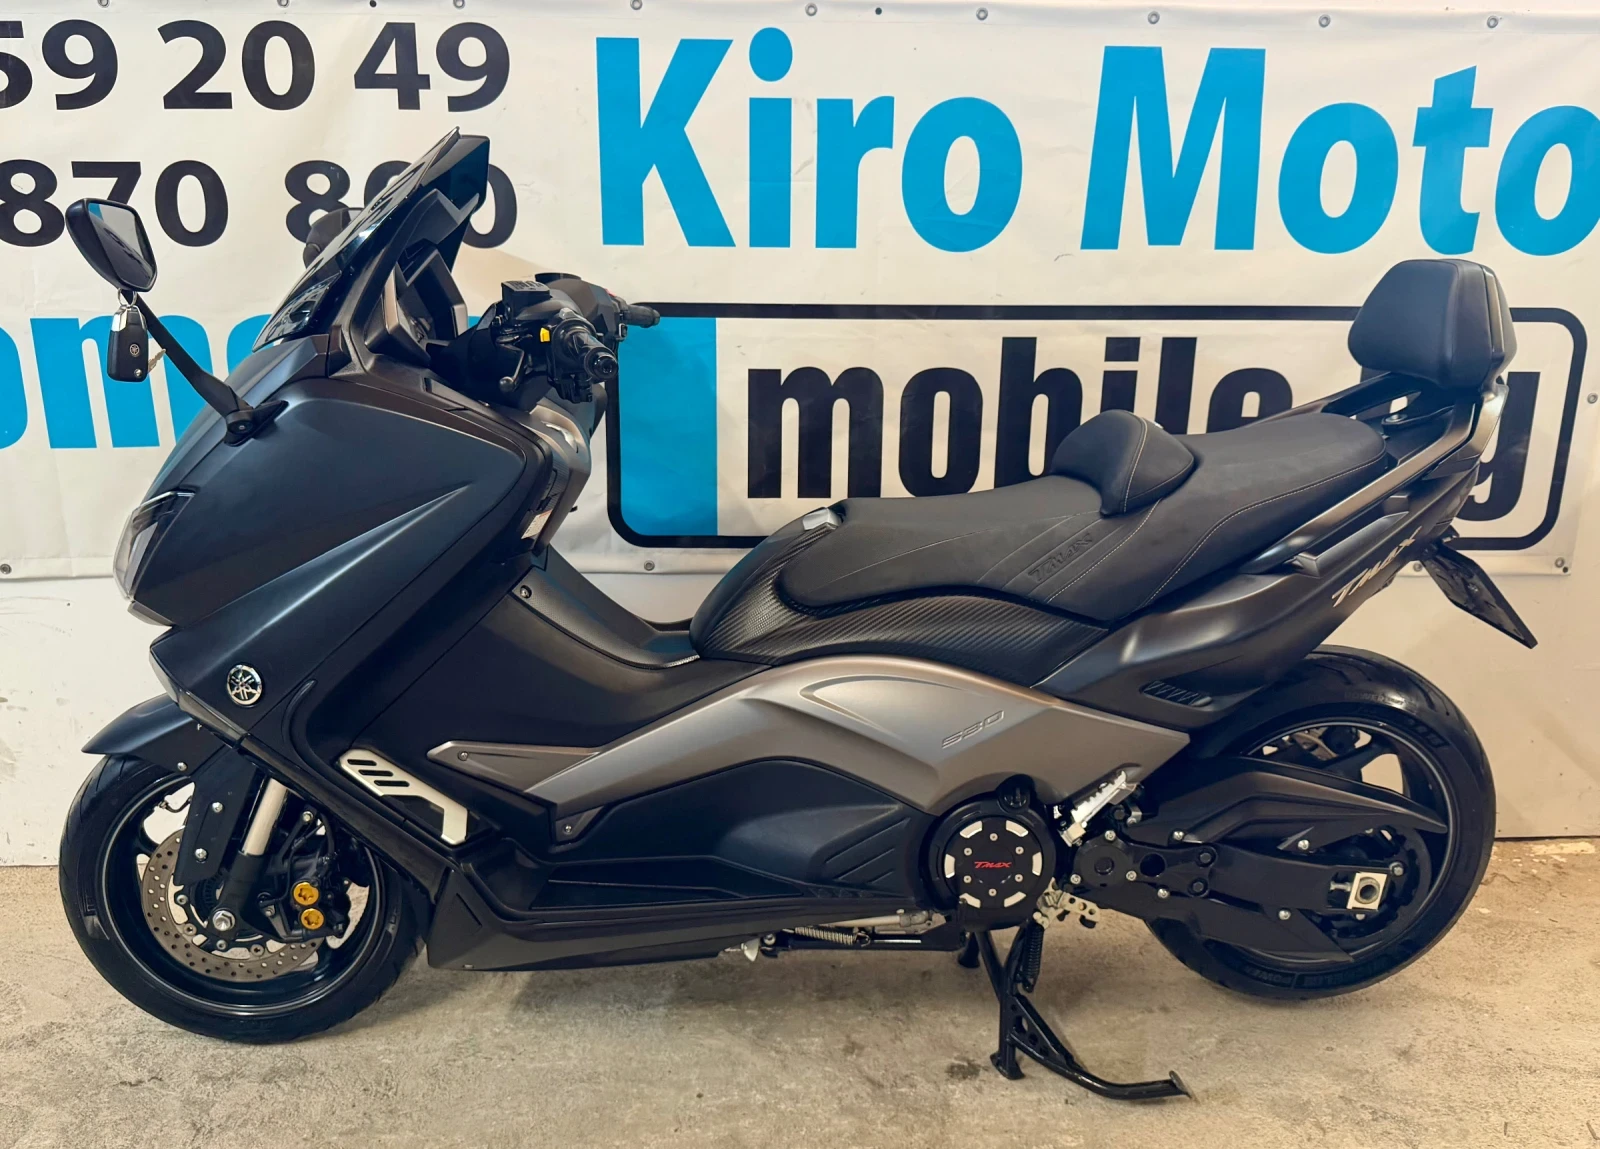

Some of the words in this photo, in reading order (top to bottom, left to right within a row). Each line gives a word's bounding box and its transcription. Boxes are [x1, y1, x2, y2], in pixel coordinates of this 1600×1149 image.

[157, 20, 315, 111] 20
[353, 22, 510, 112] 49
[596, 27, 1023, 253] Kiro
[1080, 45, 1600, 256] Moto
